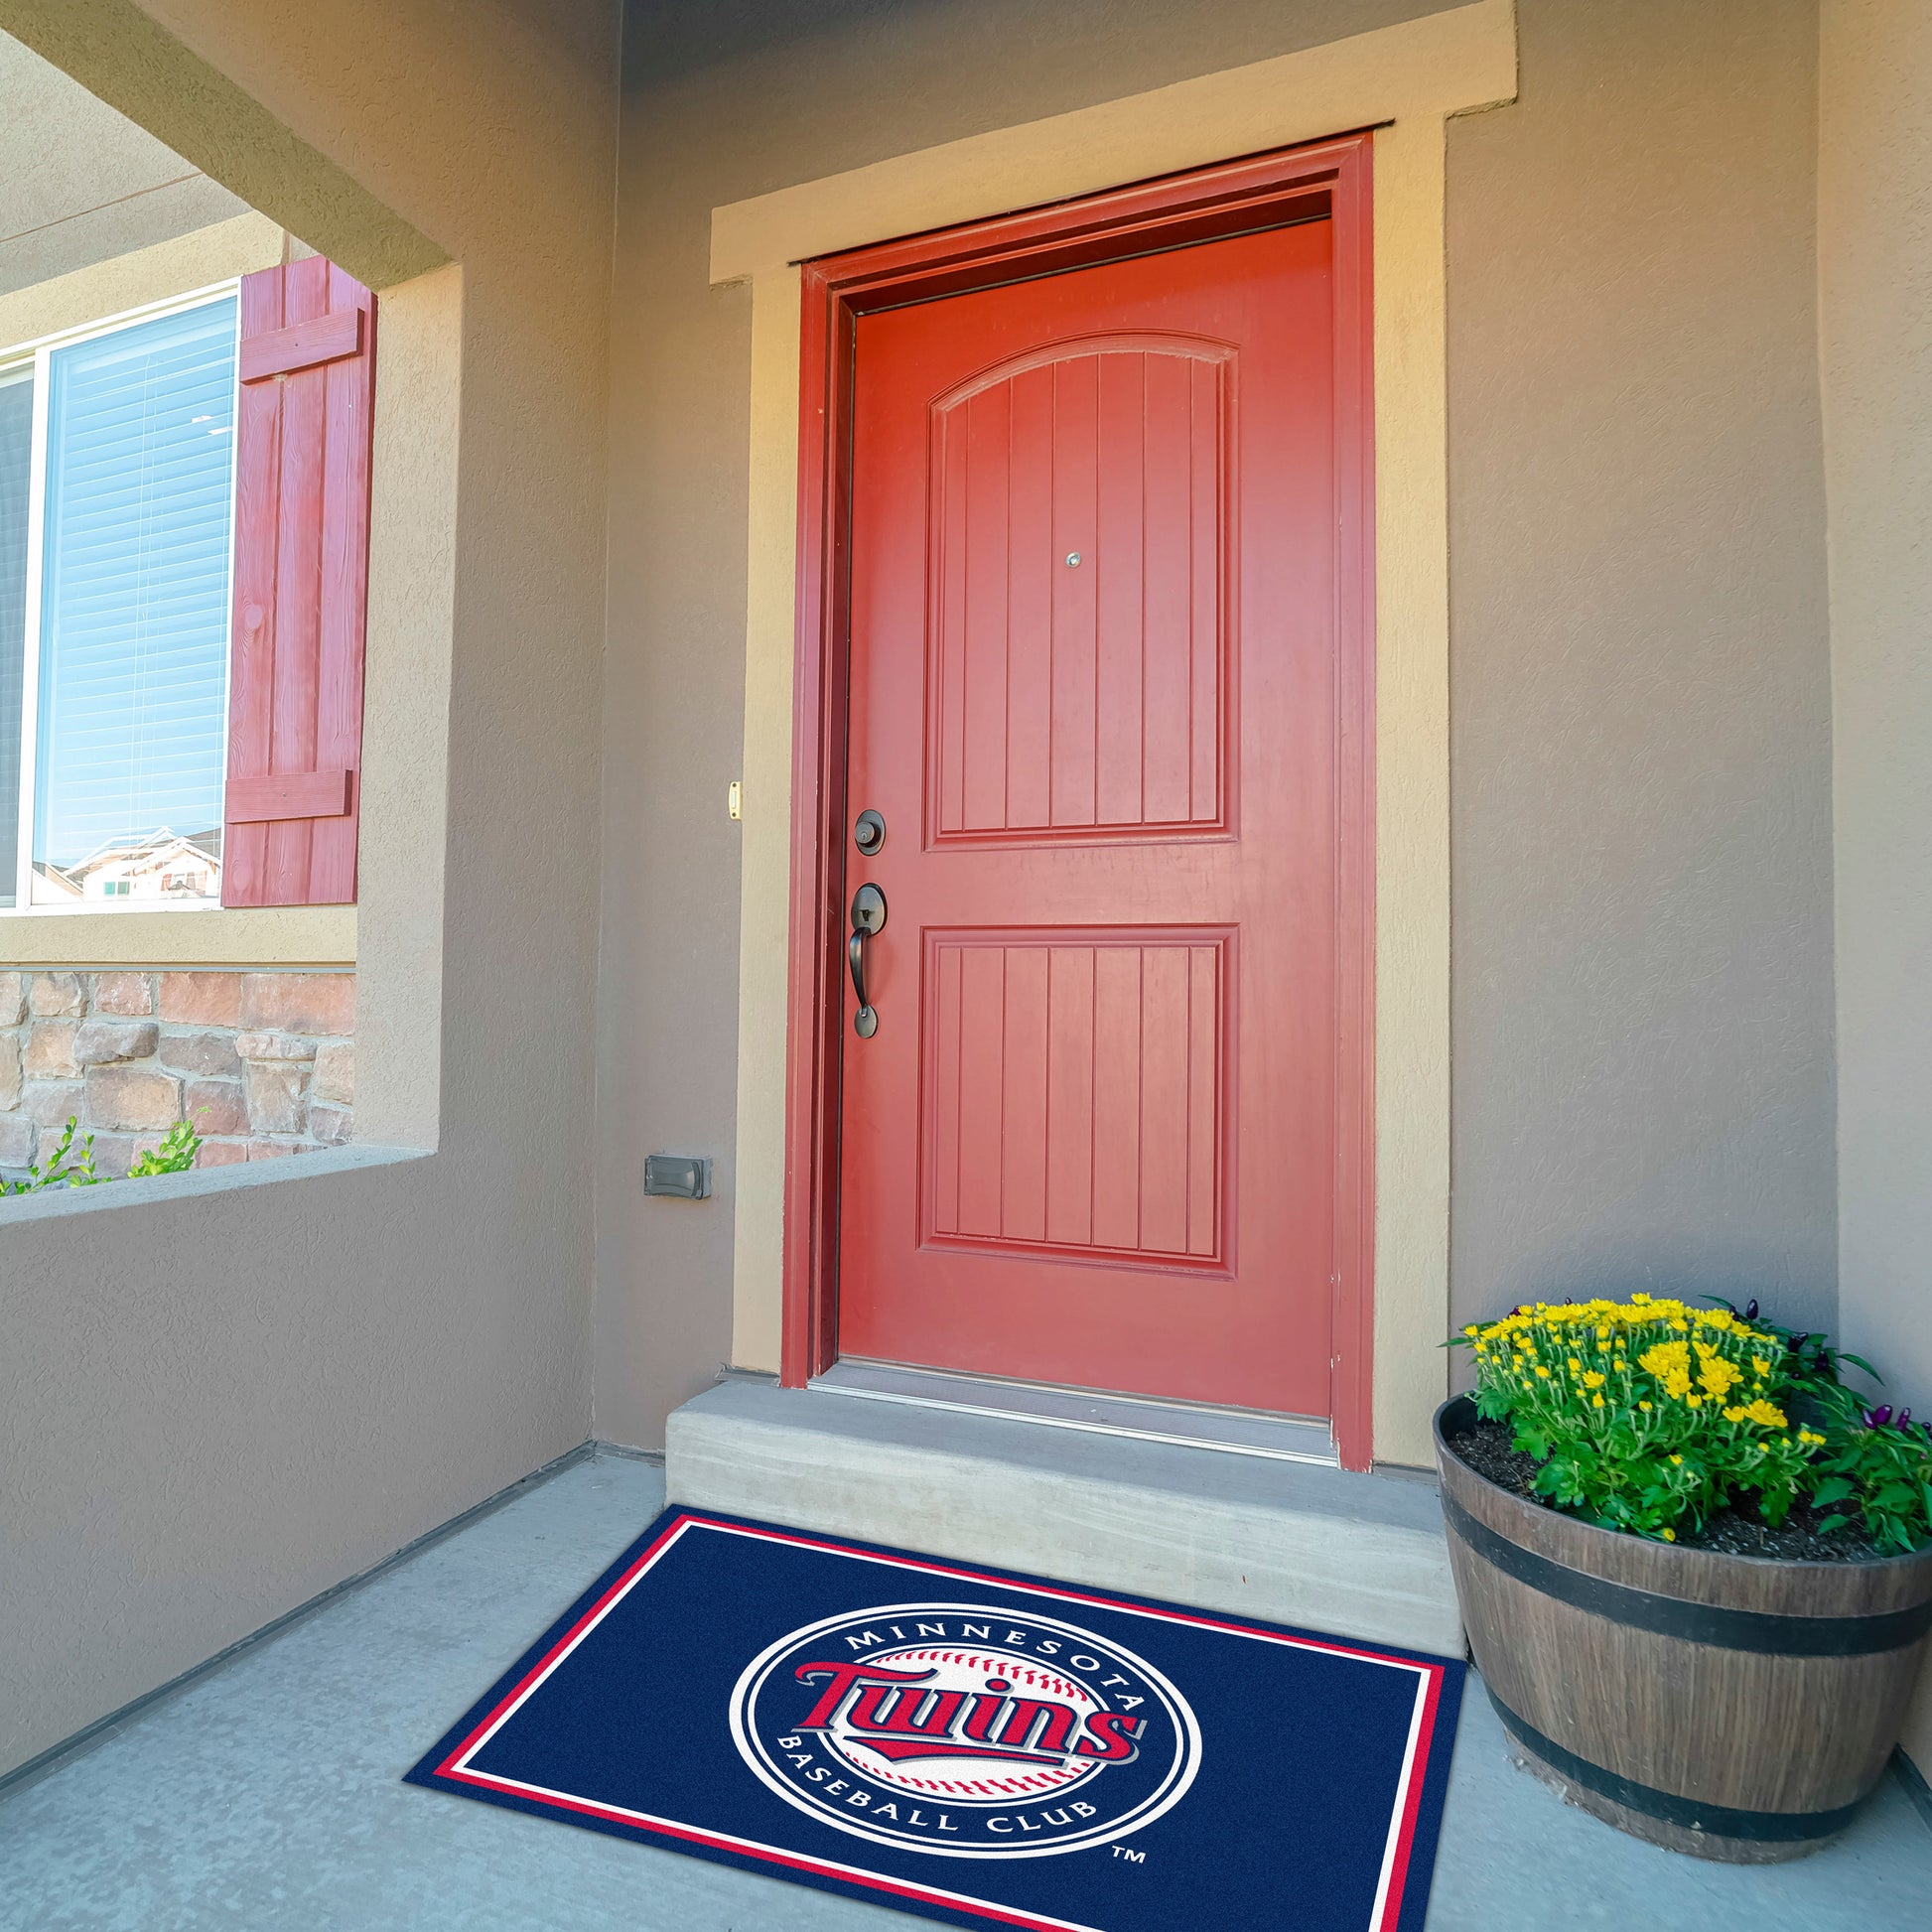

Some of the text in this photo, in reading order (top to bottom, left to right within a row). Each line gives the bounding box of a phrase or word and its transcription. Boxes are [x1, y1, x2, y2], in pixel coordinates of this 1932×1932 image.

[791, 1660, 1148, 1767] Twins
[845, 1622, 1147, 1712] MINNESOTA
[777, 1730, 1098, 1834] BASEBALL CLUB
[1112, 1845, 1147, 1863] TM
